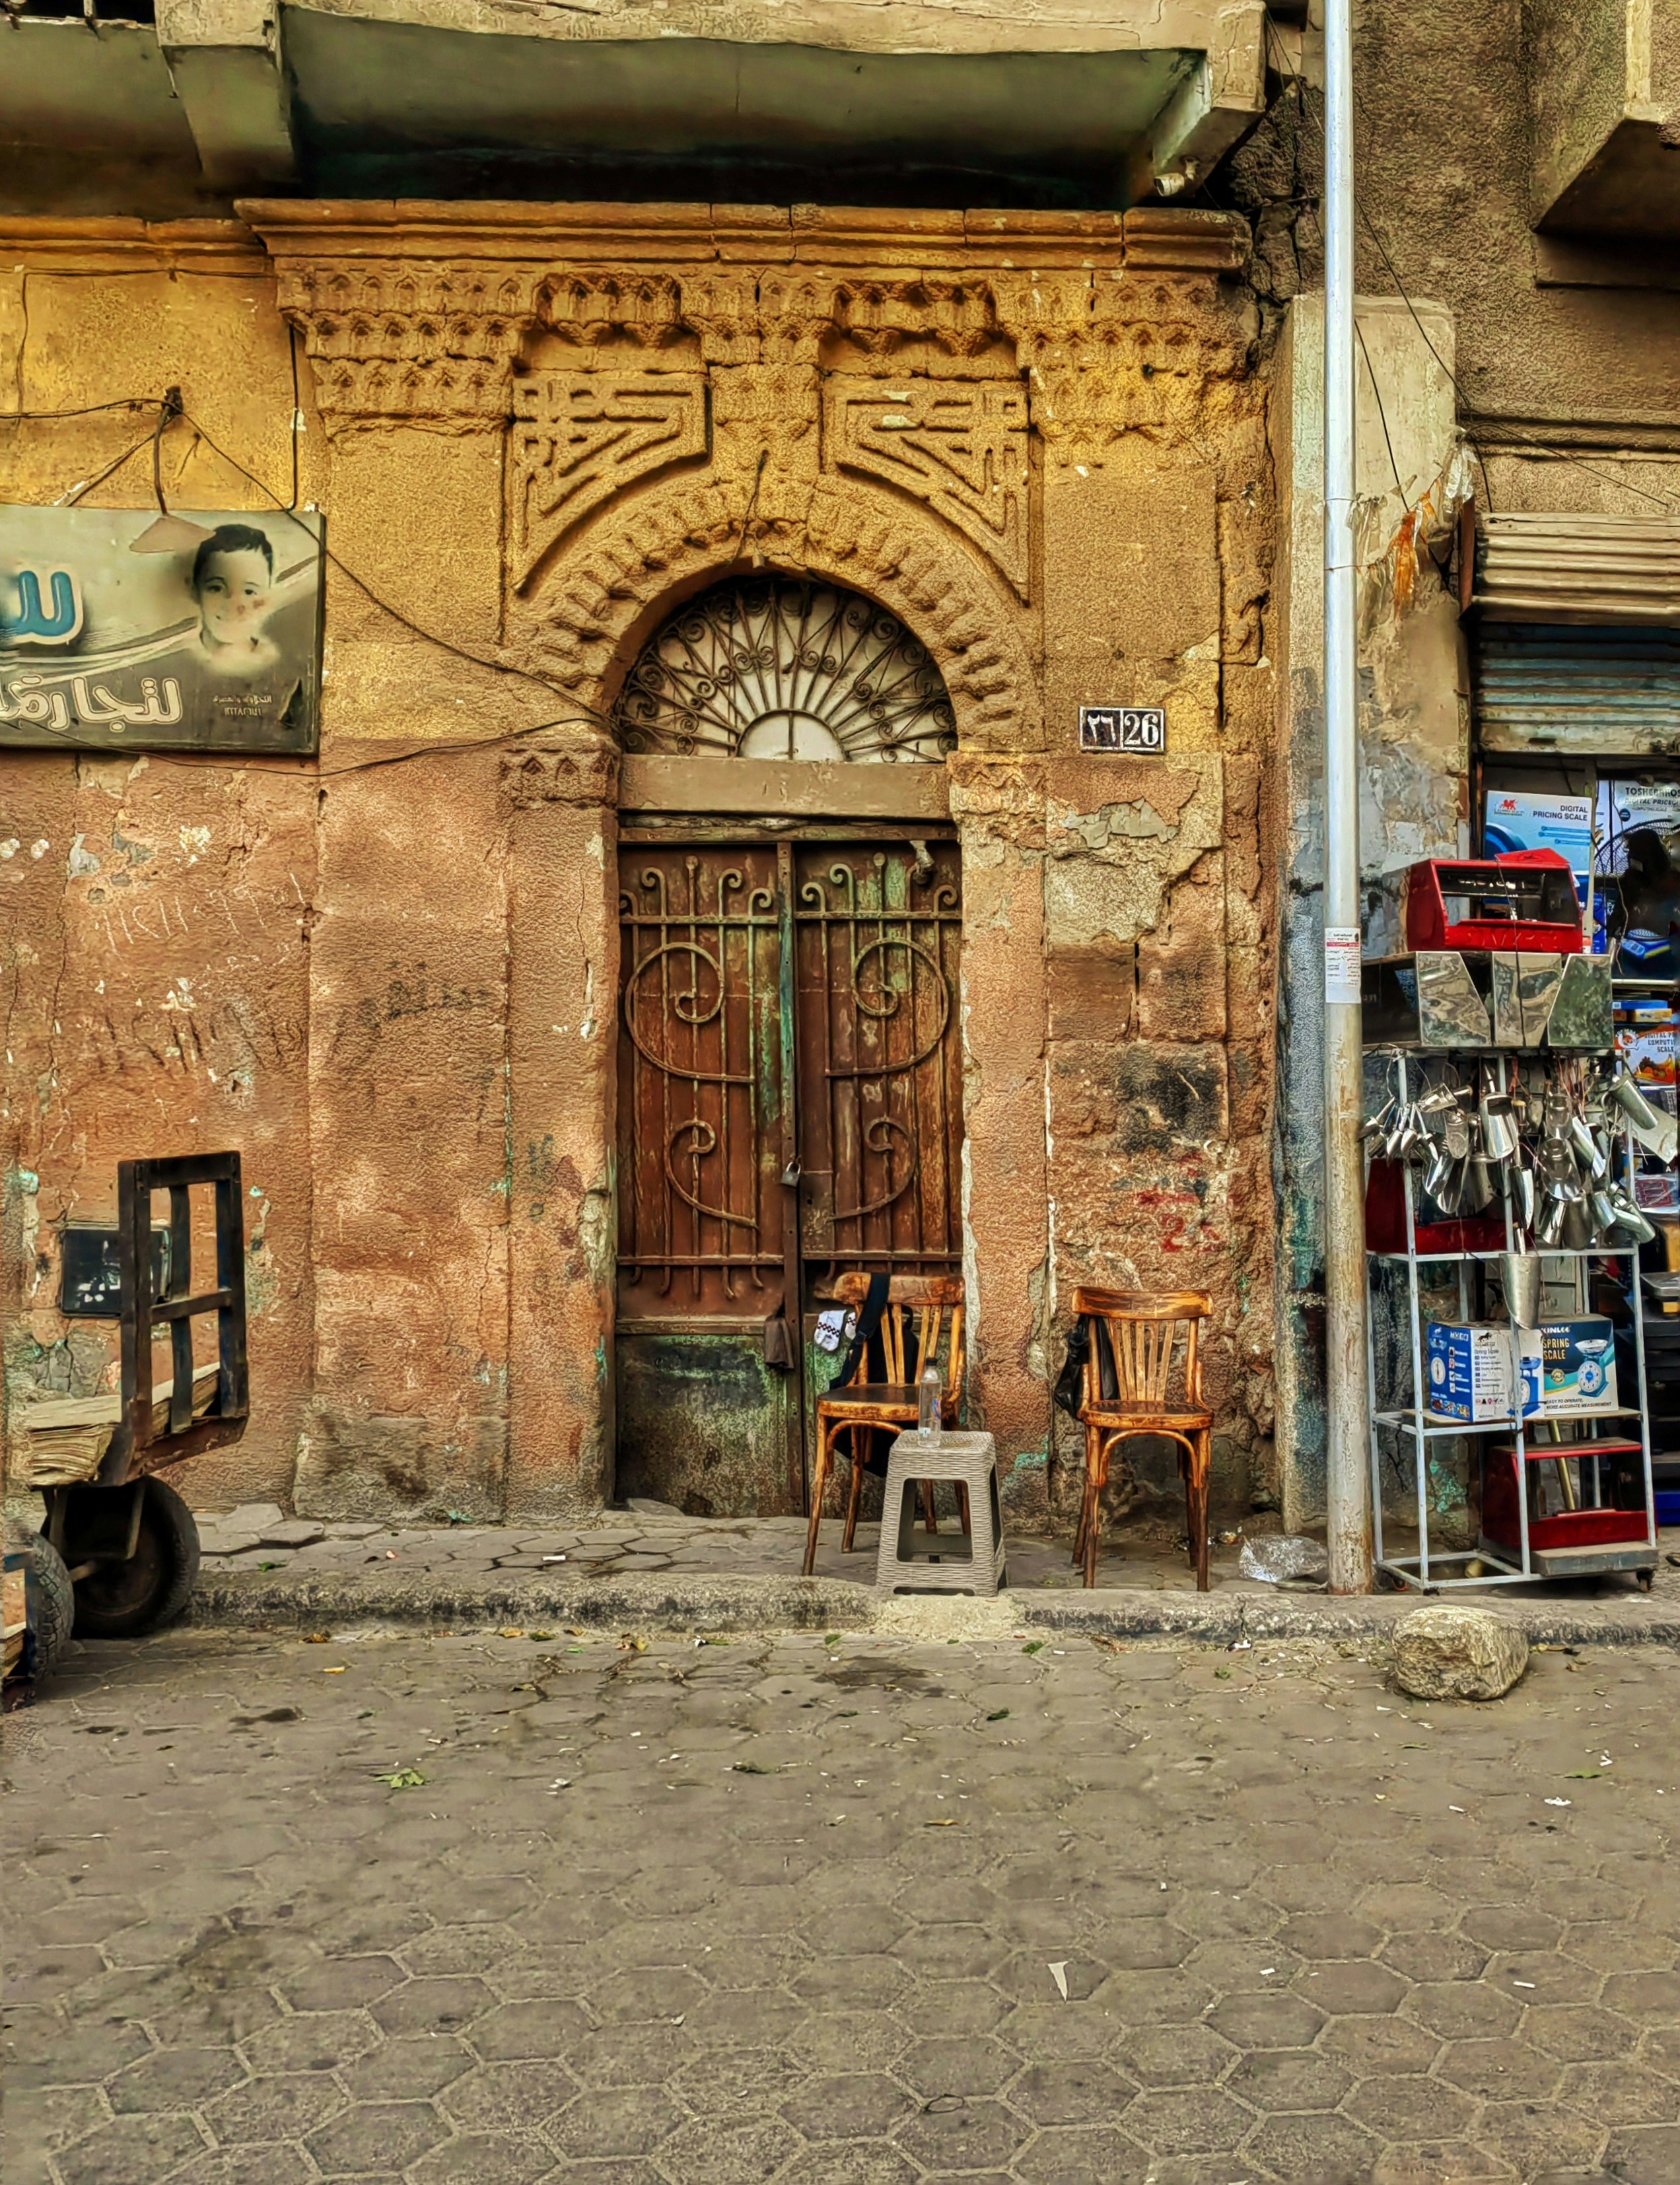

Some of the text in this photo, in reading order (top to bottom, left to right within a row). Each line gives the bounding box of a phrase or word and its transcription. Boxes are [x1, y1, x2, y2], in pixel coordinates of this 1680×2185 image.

[1087, 714, 1117, 744] ٢٦
[1124, 713, 1159, 746] 26
[1543, 1338, 1570, 1348] SPRING
[1543, 1349, 1566, 1360] SCALE
